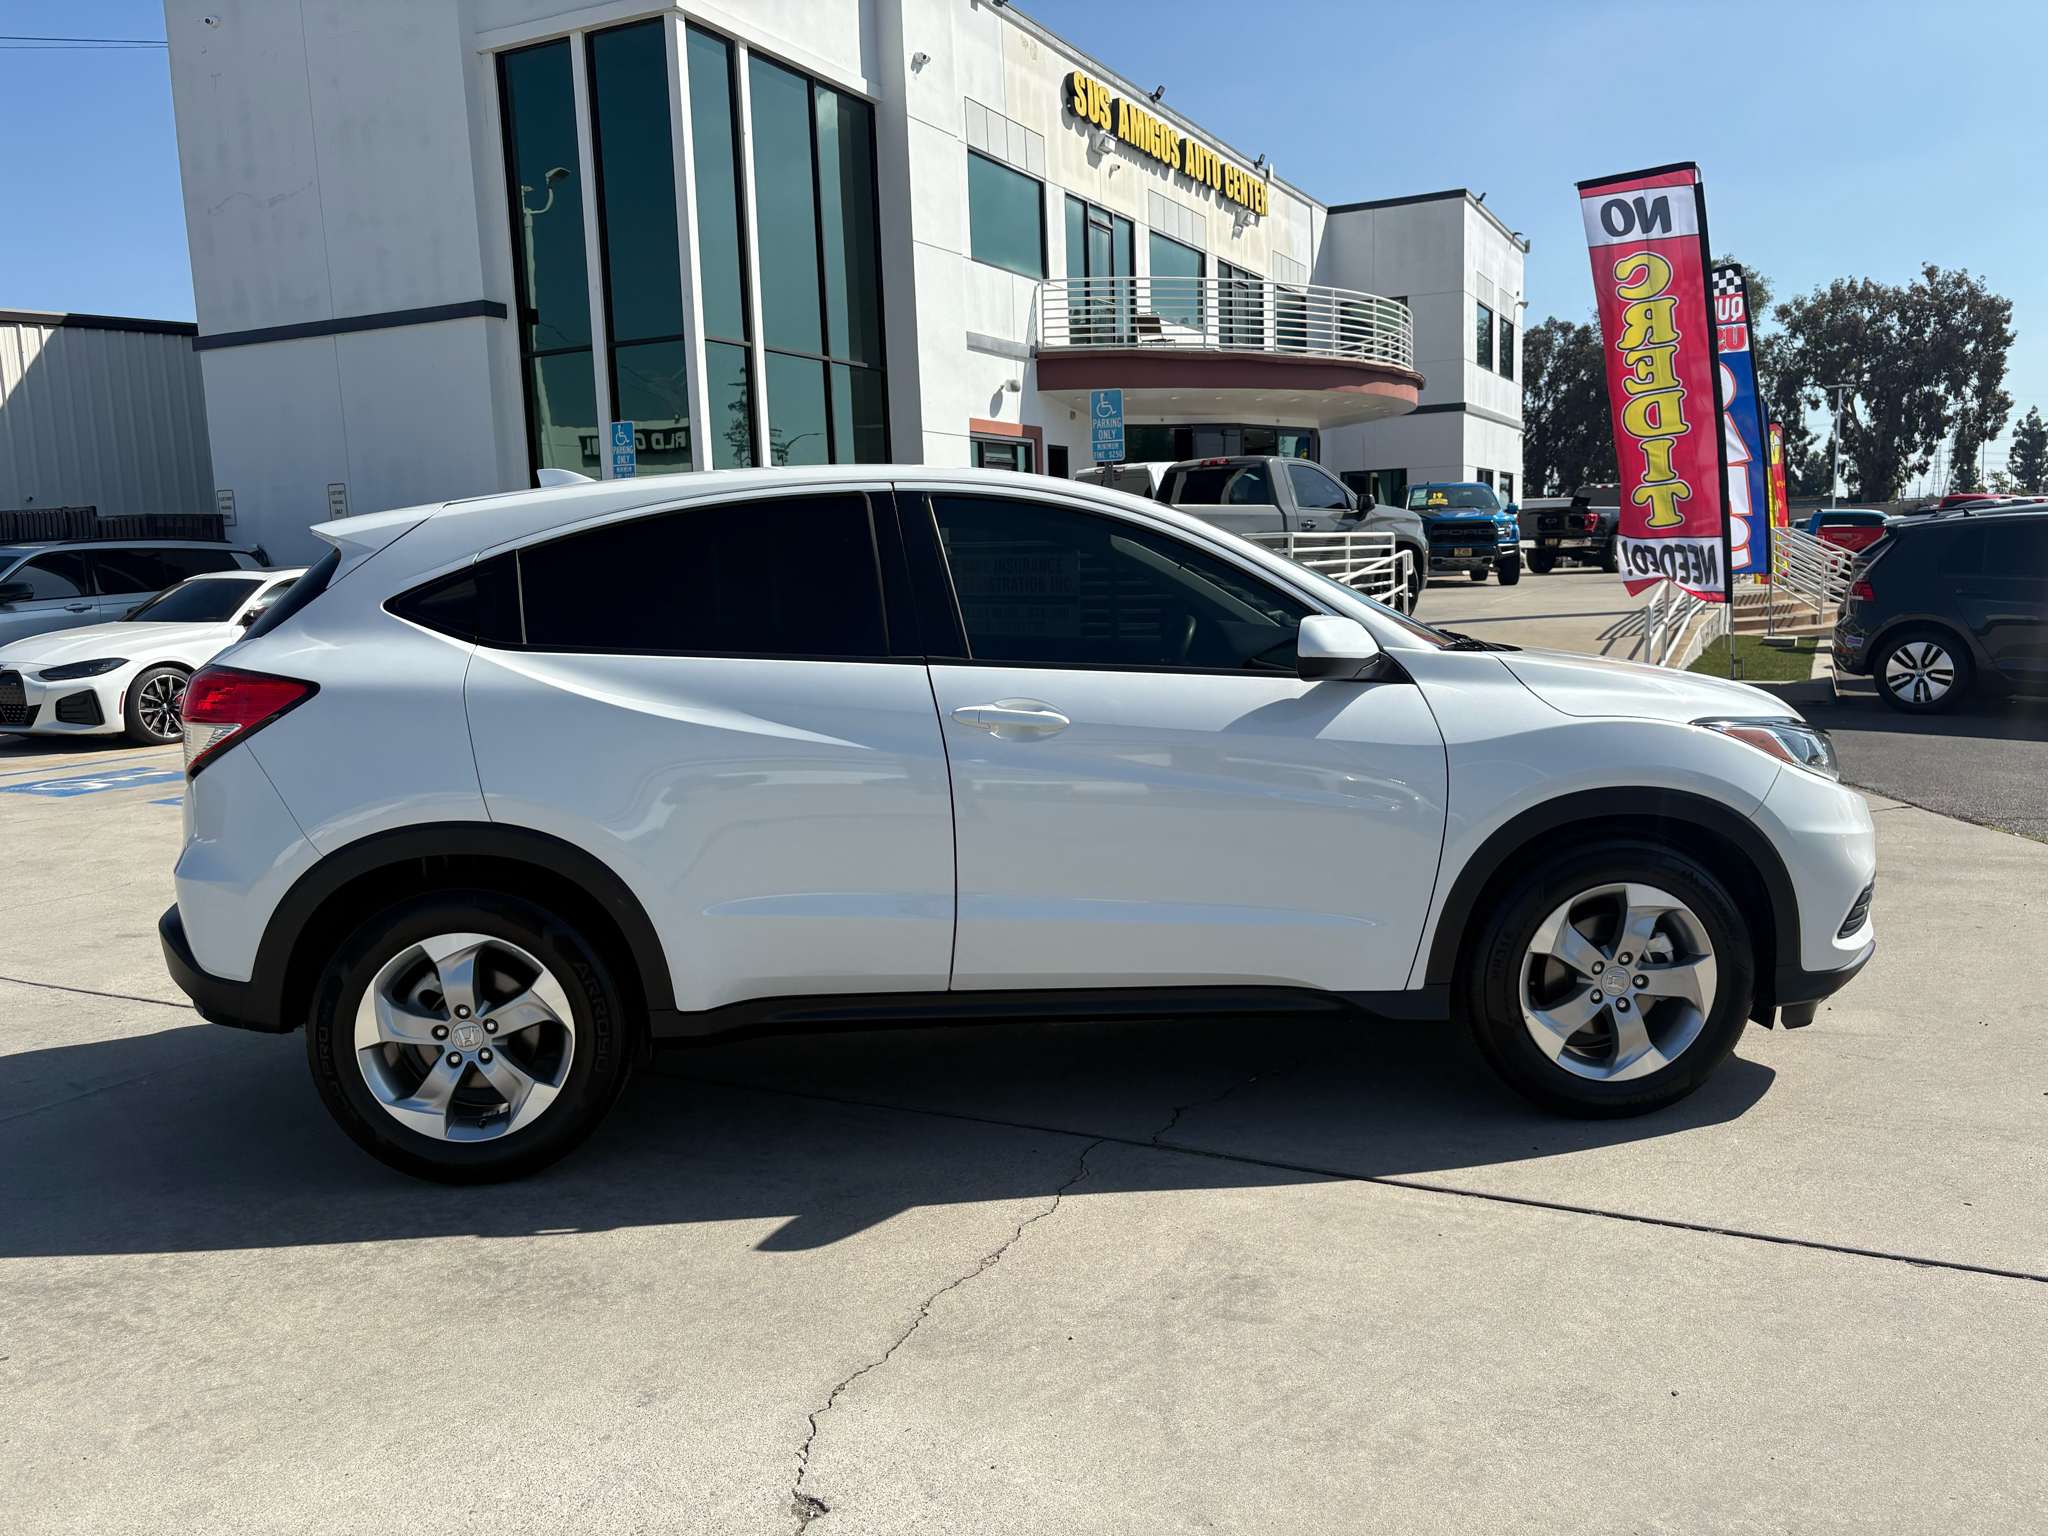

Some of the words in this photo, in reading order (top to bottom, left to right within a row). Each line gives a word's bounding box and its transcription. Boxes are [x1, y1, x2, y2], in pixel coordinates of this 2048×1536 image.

[1073, 70, 1112, 130] SUS
[1117, 97, 1180, 170] AMIGOS
[1185, 138, 1222, 191] AUTO
[1225, 162, 1268, 216] CENTER
[1092, 416, 1121, 429] PARKING
[1098, 429, 1116, 440] ONLY
[613, 445, 634, 455] PARKING
[1094, 451, 1105, 459] FINE
[617, 455, 630, 464] ONLY
[1434, 528, 1495, 536] FORD
[993, 557, 1064, 574] INSURANCE
[961, 576, 1046, 593] REGISTRATION
[572, 961, 610, 1074] ARROYO
[318, 1026, 334, 1076] PRO
